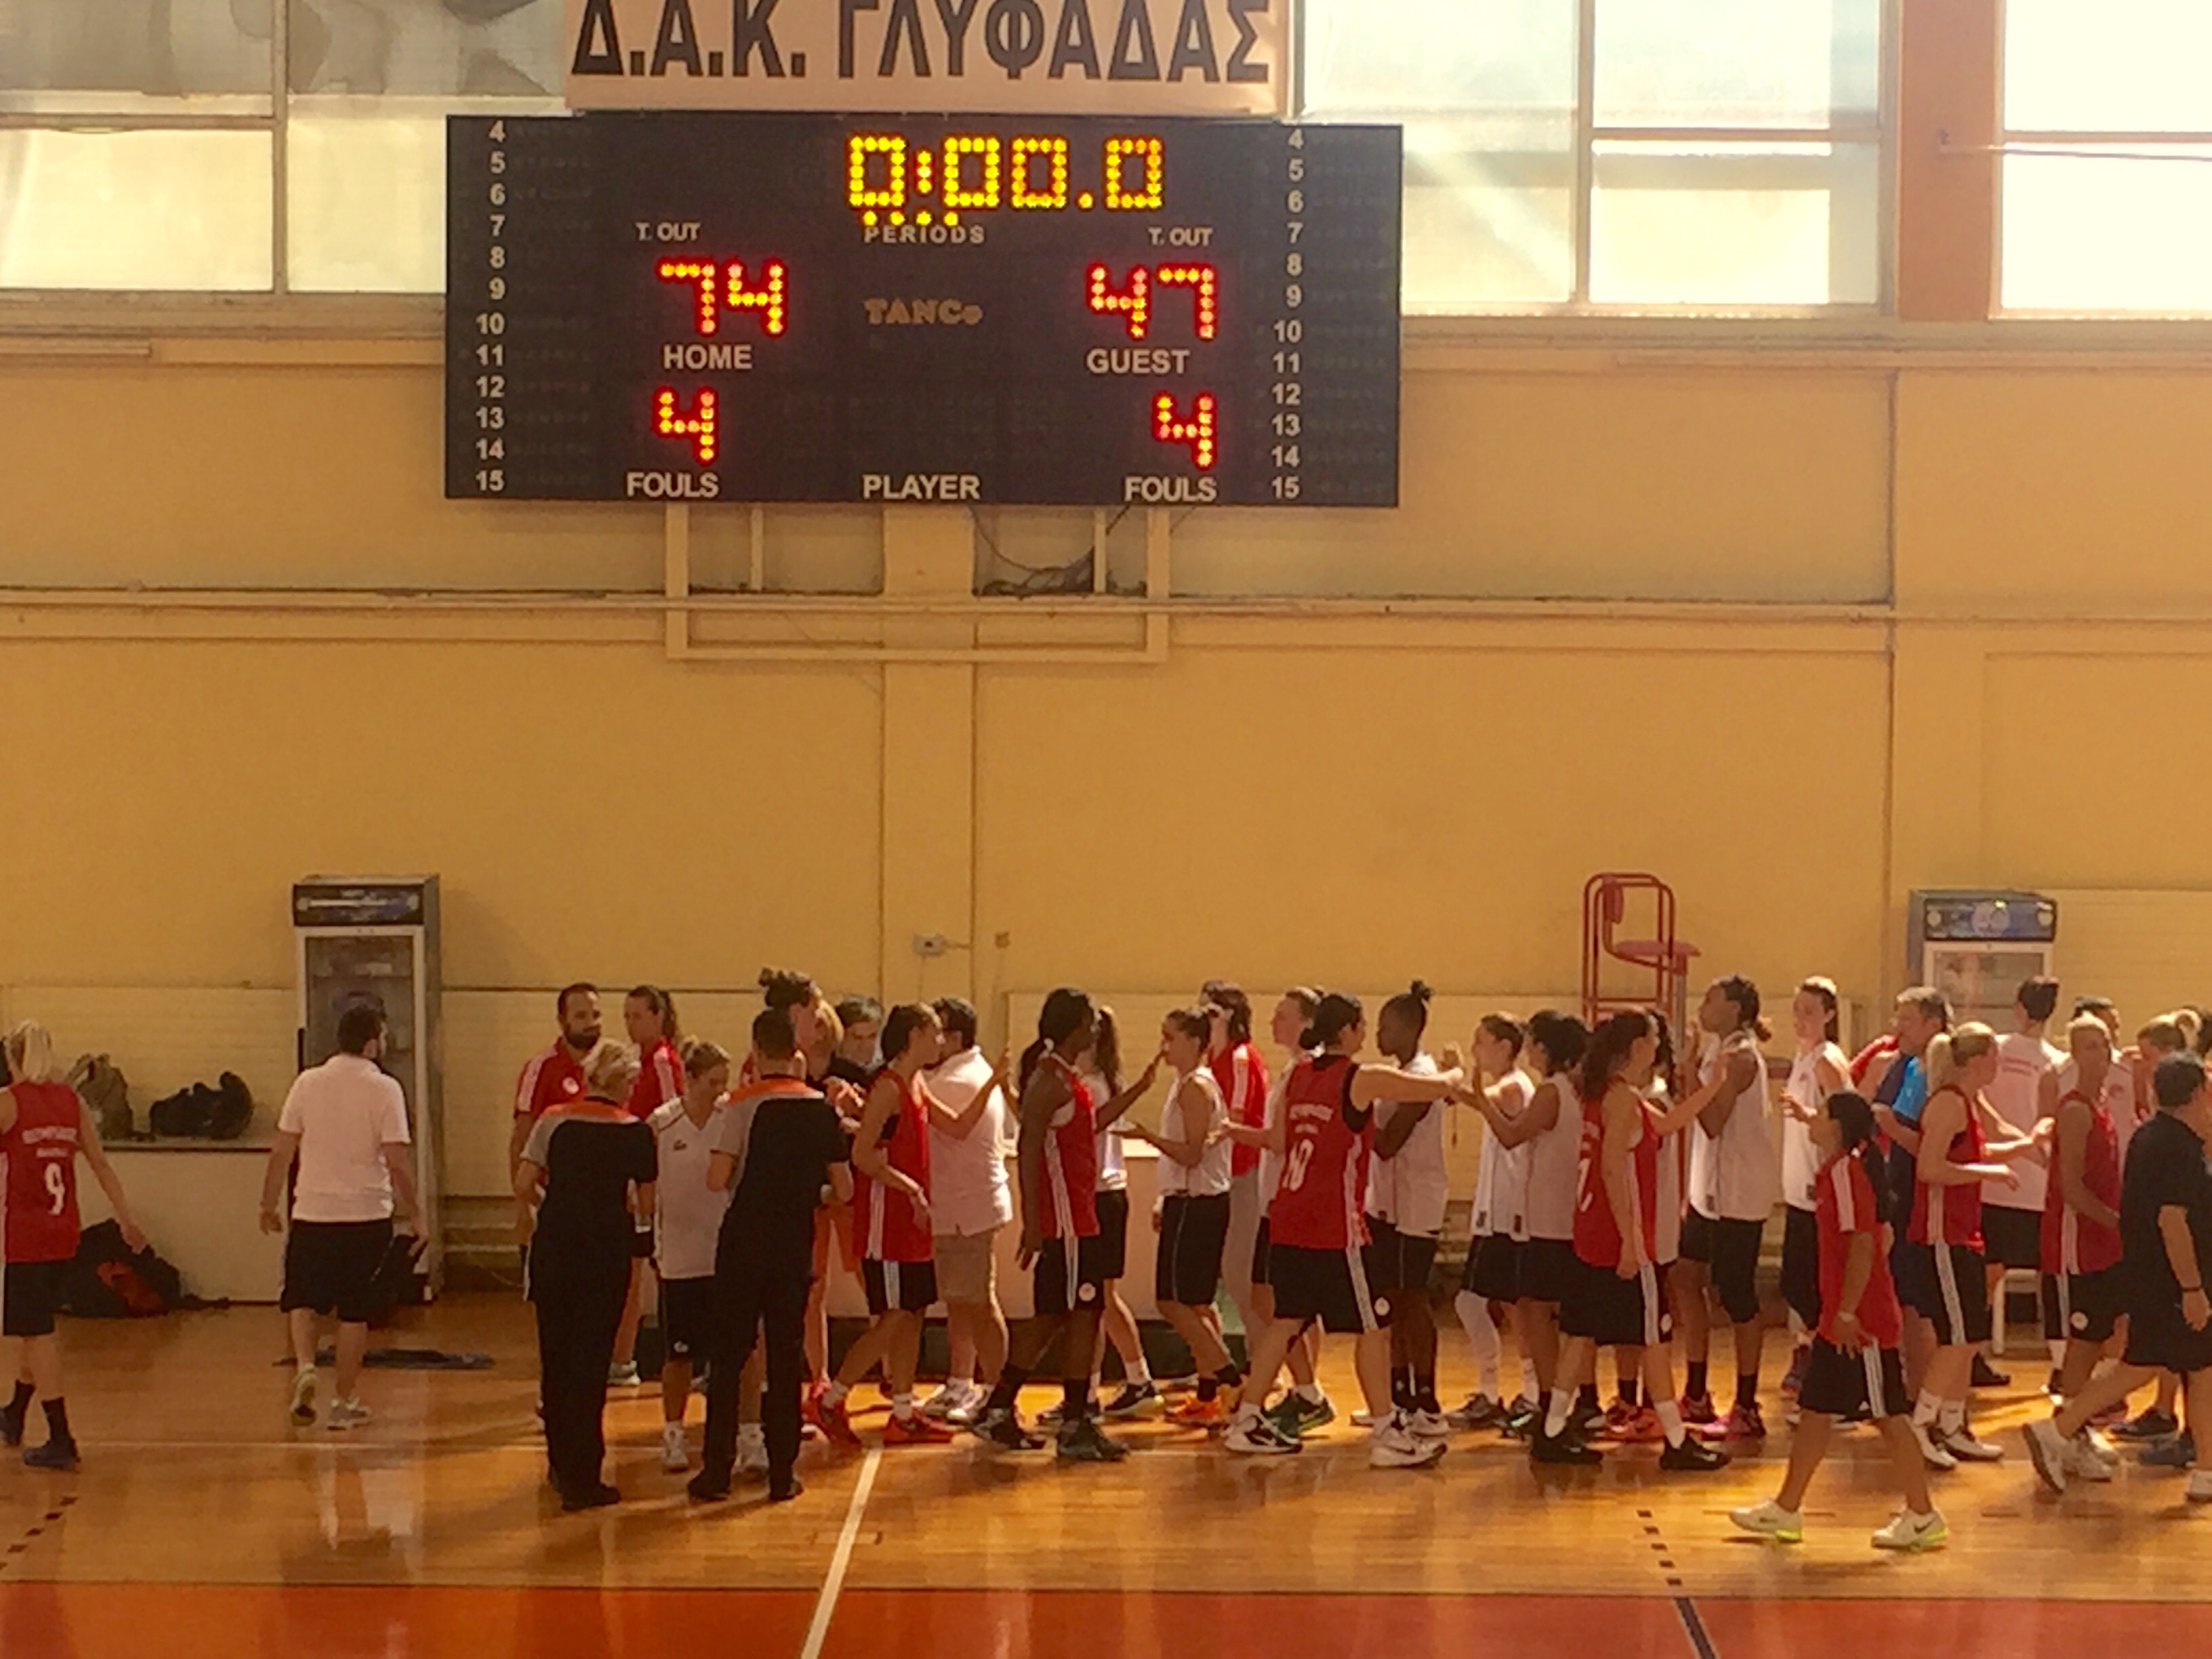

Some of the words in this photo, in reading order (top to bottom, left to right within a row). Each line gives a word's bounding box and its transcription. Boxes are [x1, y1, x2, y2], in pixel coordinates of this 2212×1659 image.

[571, 0, 806, 77] Δ.Α.Κ.
[838, 0, 1269, 83] ΓΛΥΦΑΔΑΣ
[489, 120, 506, 143] 4
[1288, 129, 1304, 150] 4
[489, 151, 506, 173] 5
[1288, 159, 1304, 182] 5
[489, 183, 506, 206] 6
[1288, 191, 1304, 213] 6
[489, 216, 506, 237] 7
[657, 222, 701, 242] OUT
[863, 224, 985, 244] PERIODS
[1147, 226, 1165, 245] T.
[1168, 226, 1214, 247] OUT
[1288, 223, 1304, 244] 7
[489, 247, 506, 269] 8
[1286, 253, 1303, 276] 8
[489, 277, 506, 300] 9
[658, 260, 785, 335] 74
[1286, 285, 1303, 308] 9
[1089, 264, 1215, 339] 47
[476, 312, 506, 335] 10
[1273, 320, 1303, 342] 10
[476, 344, 506, 367] 11
[663, 344, 753, 370] HOME
[1086, 348, 1191, 375] GUEST
[1273, 352, 1302, 374] 11
[476, 376, 506, 398] 12
[1271, 383, 1301, 405] 12
[476, 408, 506, 430] 13
[657, 389, 716, 463] 4
[1155, 393, 1213, 468] 4
[1271, 414, 1301, 437] 13
[476, 439, 506, 461] 14
[1271, 445, 1300, 468] 14
[476, 470, 506, 493] 15
[626, 472, 720, 499] FOULS
[862, 474, 981, 501] PLAYER
[1124, 476, 1218, 503] FOULS
[1271, 476, 1300, 499] 15
[44, 1162, 66, 1216] 9
